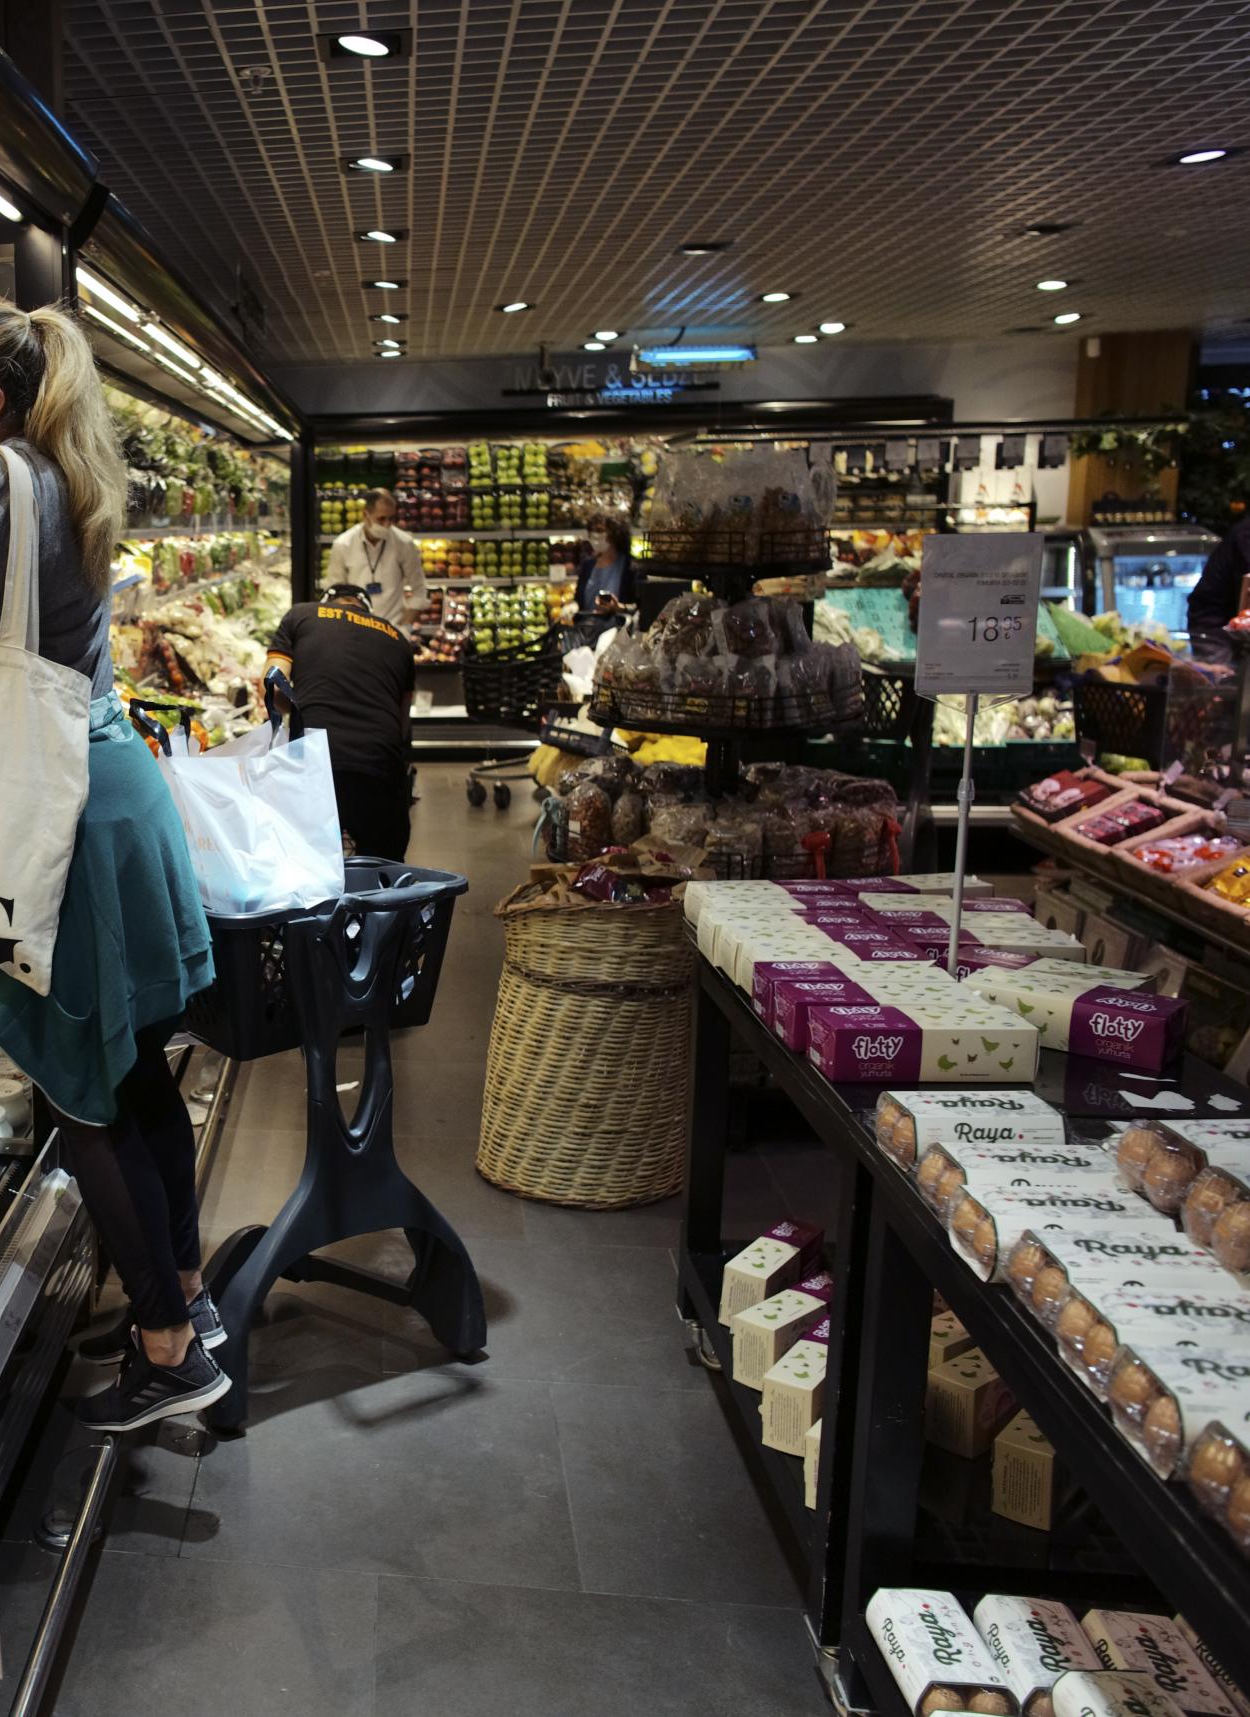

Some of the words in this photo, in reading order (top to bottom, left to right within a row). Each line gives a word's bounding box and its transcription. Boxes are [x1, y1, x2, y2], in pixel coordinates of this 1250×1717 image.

[606, 362, 622, 388] &
[598, 389, 673, 405] VEGETABLES
[317, 606, 343, 620] EST
[968, 616, 999, 642] 18
[1089, 1013, 1145, 1042] flotty
[853, 1036, 904, 1061] flotty
[1094, 1037, 1136, 1053] organik
[1098, 1046, 1132, 1061] yumurta
[858, 1061, 896, 1073] organik
[860, 1070, 893, 1079] yumurta
